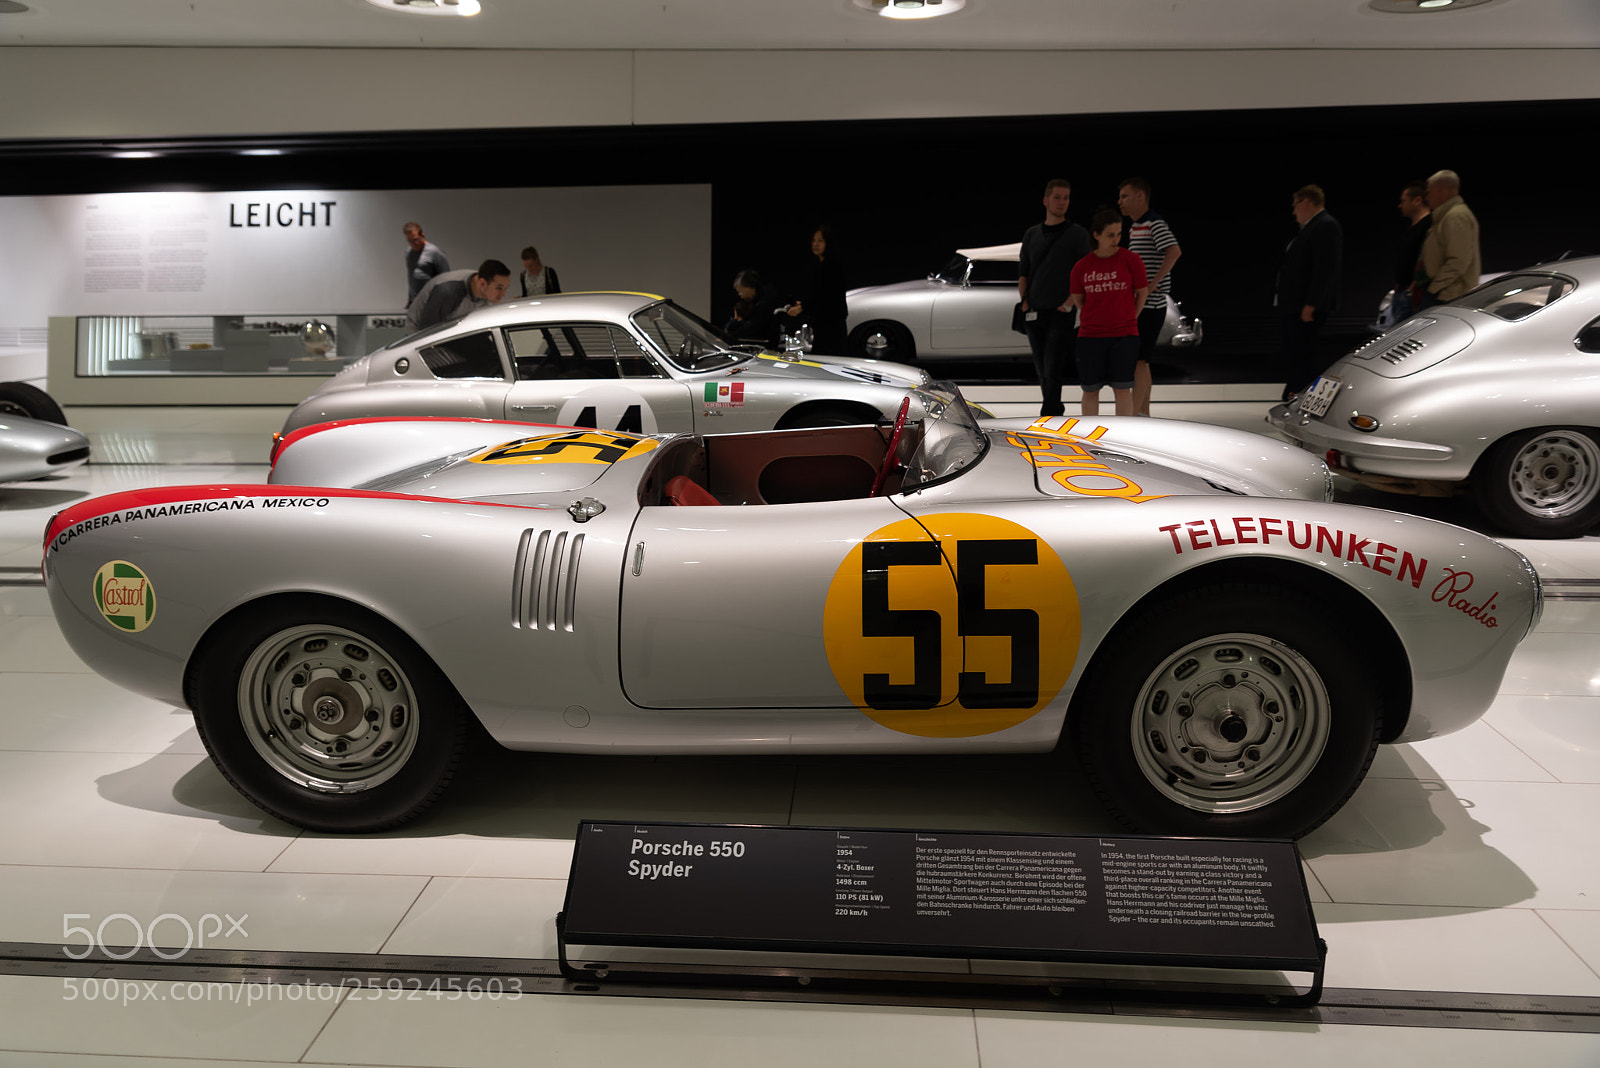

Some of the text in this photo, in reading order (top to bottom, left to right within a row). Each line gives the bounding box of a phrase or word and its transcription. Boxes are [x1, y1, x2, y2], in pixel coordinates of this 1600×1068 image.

[230, 201, 337, 227] LEICHT
[58, 513, 121, 547] CARRERA
[125, 499, 255, 523] PANAMERICANA
[262, 498, 330, 509] MEXICO
[1159, 516, 1499, 629] TELEFUNKEN Radio
[103, 578, 146, 615] Castrol
[862, 539, 1040, 710] 55
[631, 838, 745, 858] Porsche 550
[627, 859, 693, 880] Spyder
[856, 864, 875, 872] Boxer
[836, 878, 868, 887] 1498 ccm
[858, 894, 869, 902] (81
[835, 908, 868, 917] 220 km/h
